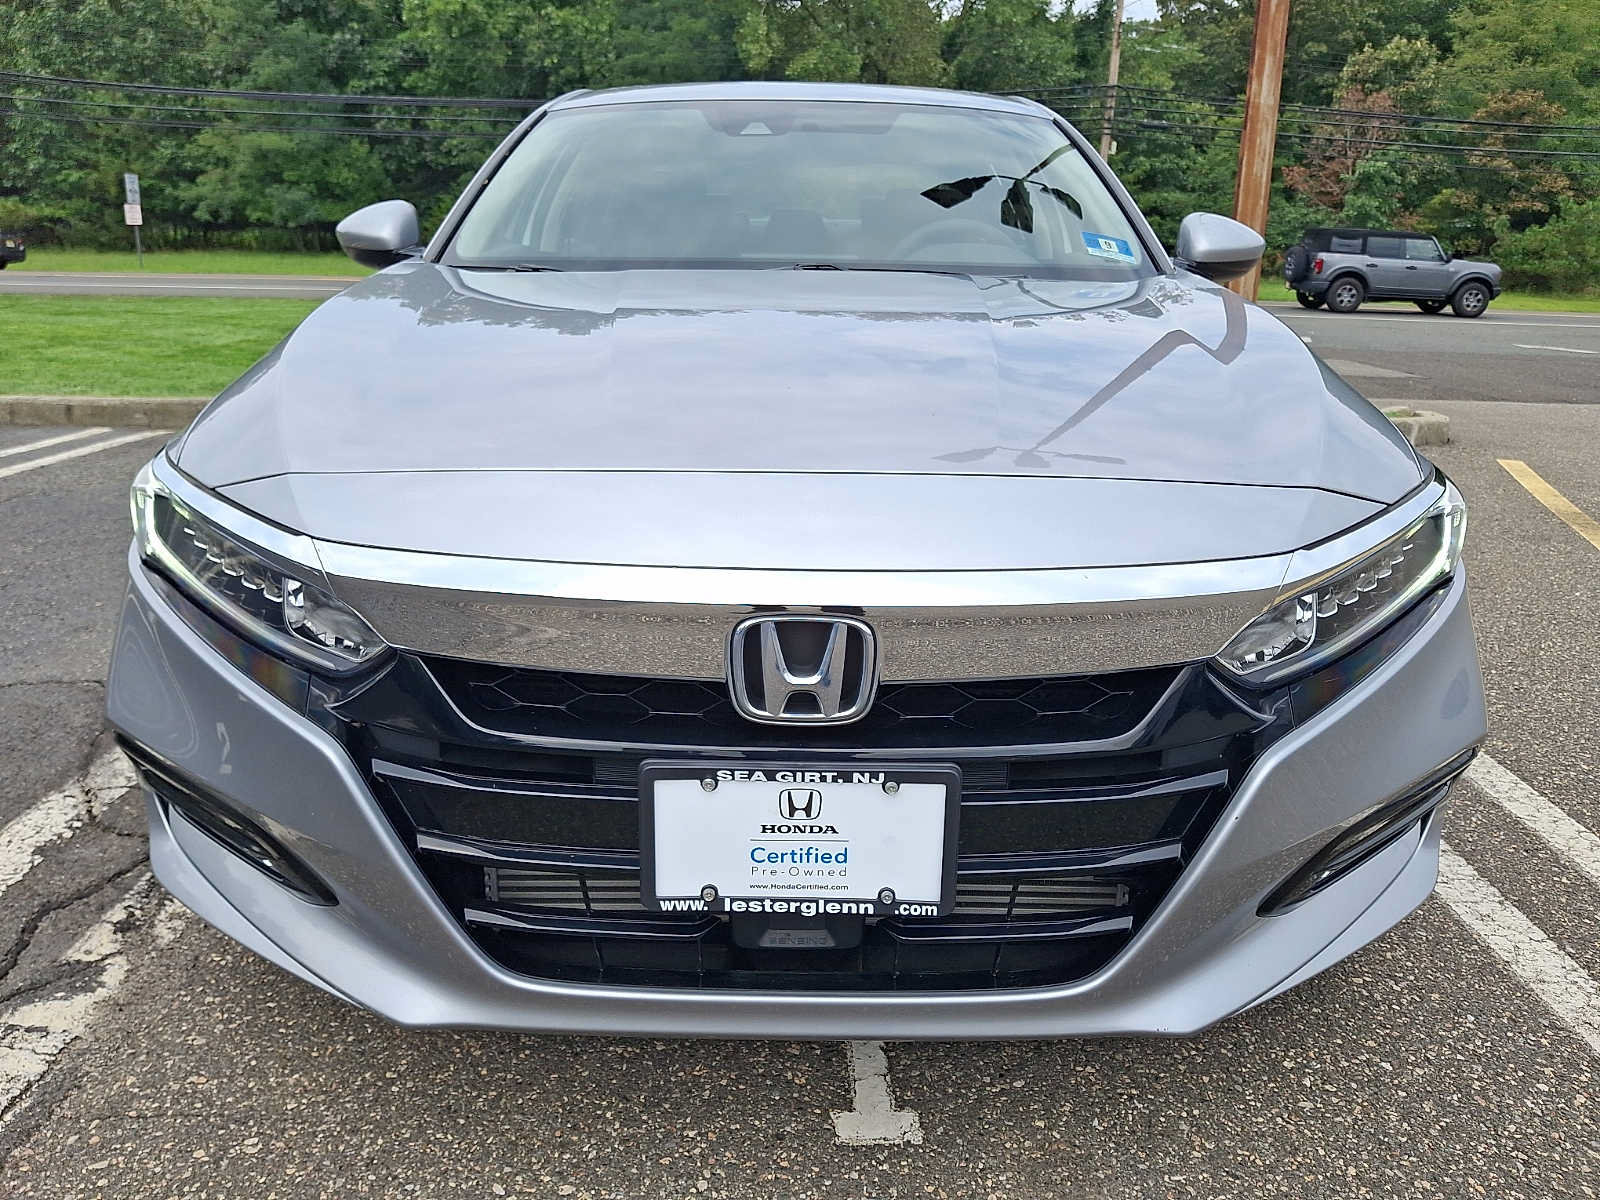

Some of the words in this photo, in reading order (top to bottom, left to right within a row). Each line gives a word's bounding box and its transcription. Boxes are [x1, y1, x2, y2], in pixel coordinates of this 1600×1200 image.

[716, 771, 768, 783] SEA
[775, 771, 844, 785] GIRT,
[853, 772, 885, 784] NJ
[760, 824, 839, 835] HONDA
[750, 846, 848, 865] Certified
[751, 866, 848, 877] Pre-Owned
[749, 883, 849, 892] www.HondaCertified.com
[724, 898, 874, 917] lesterglenn
